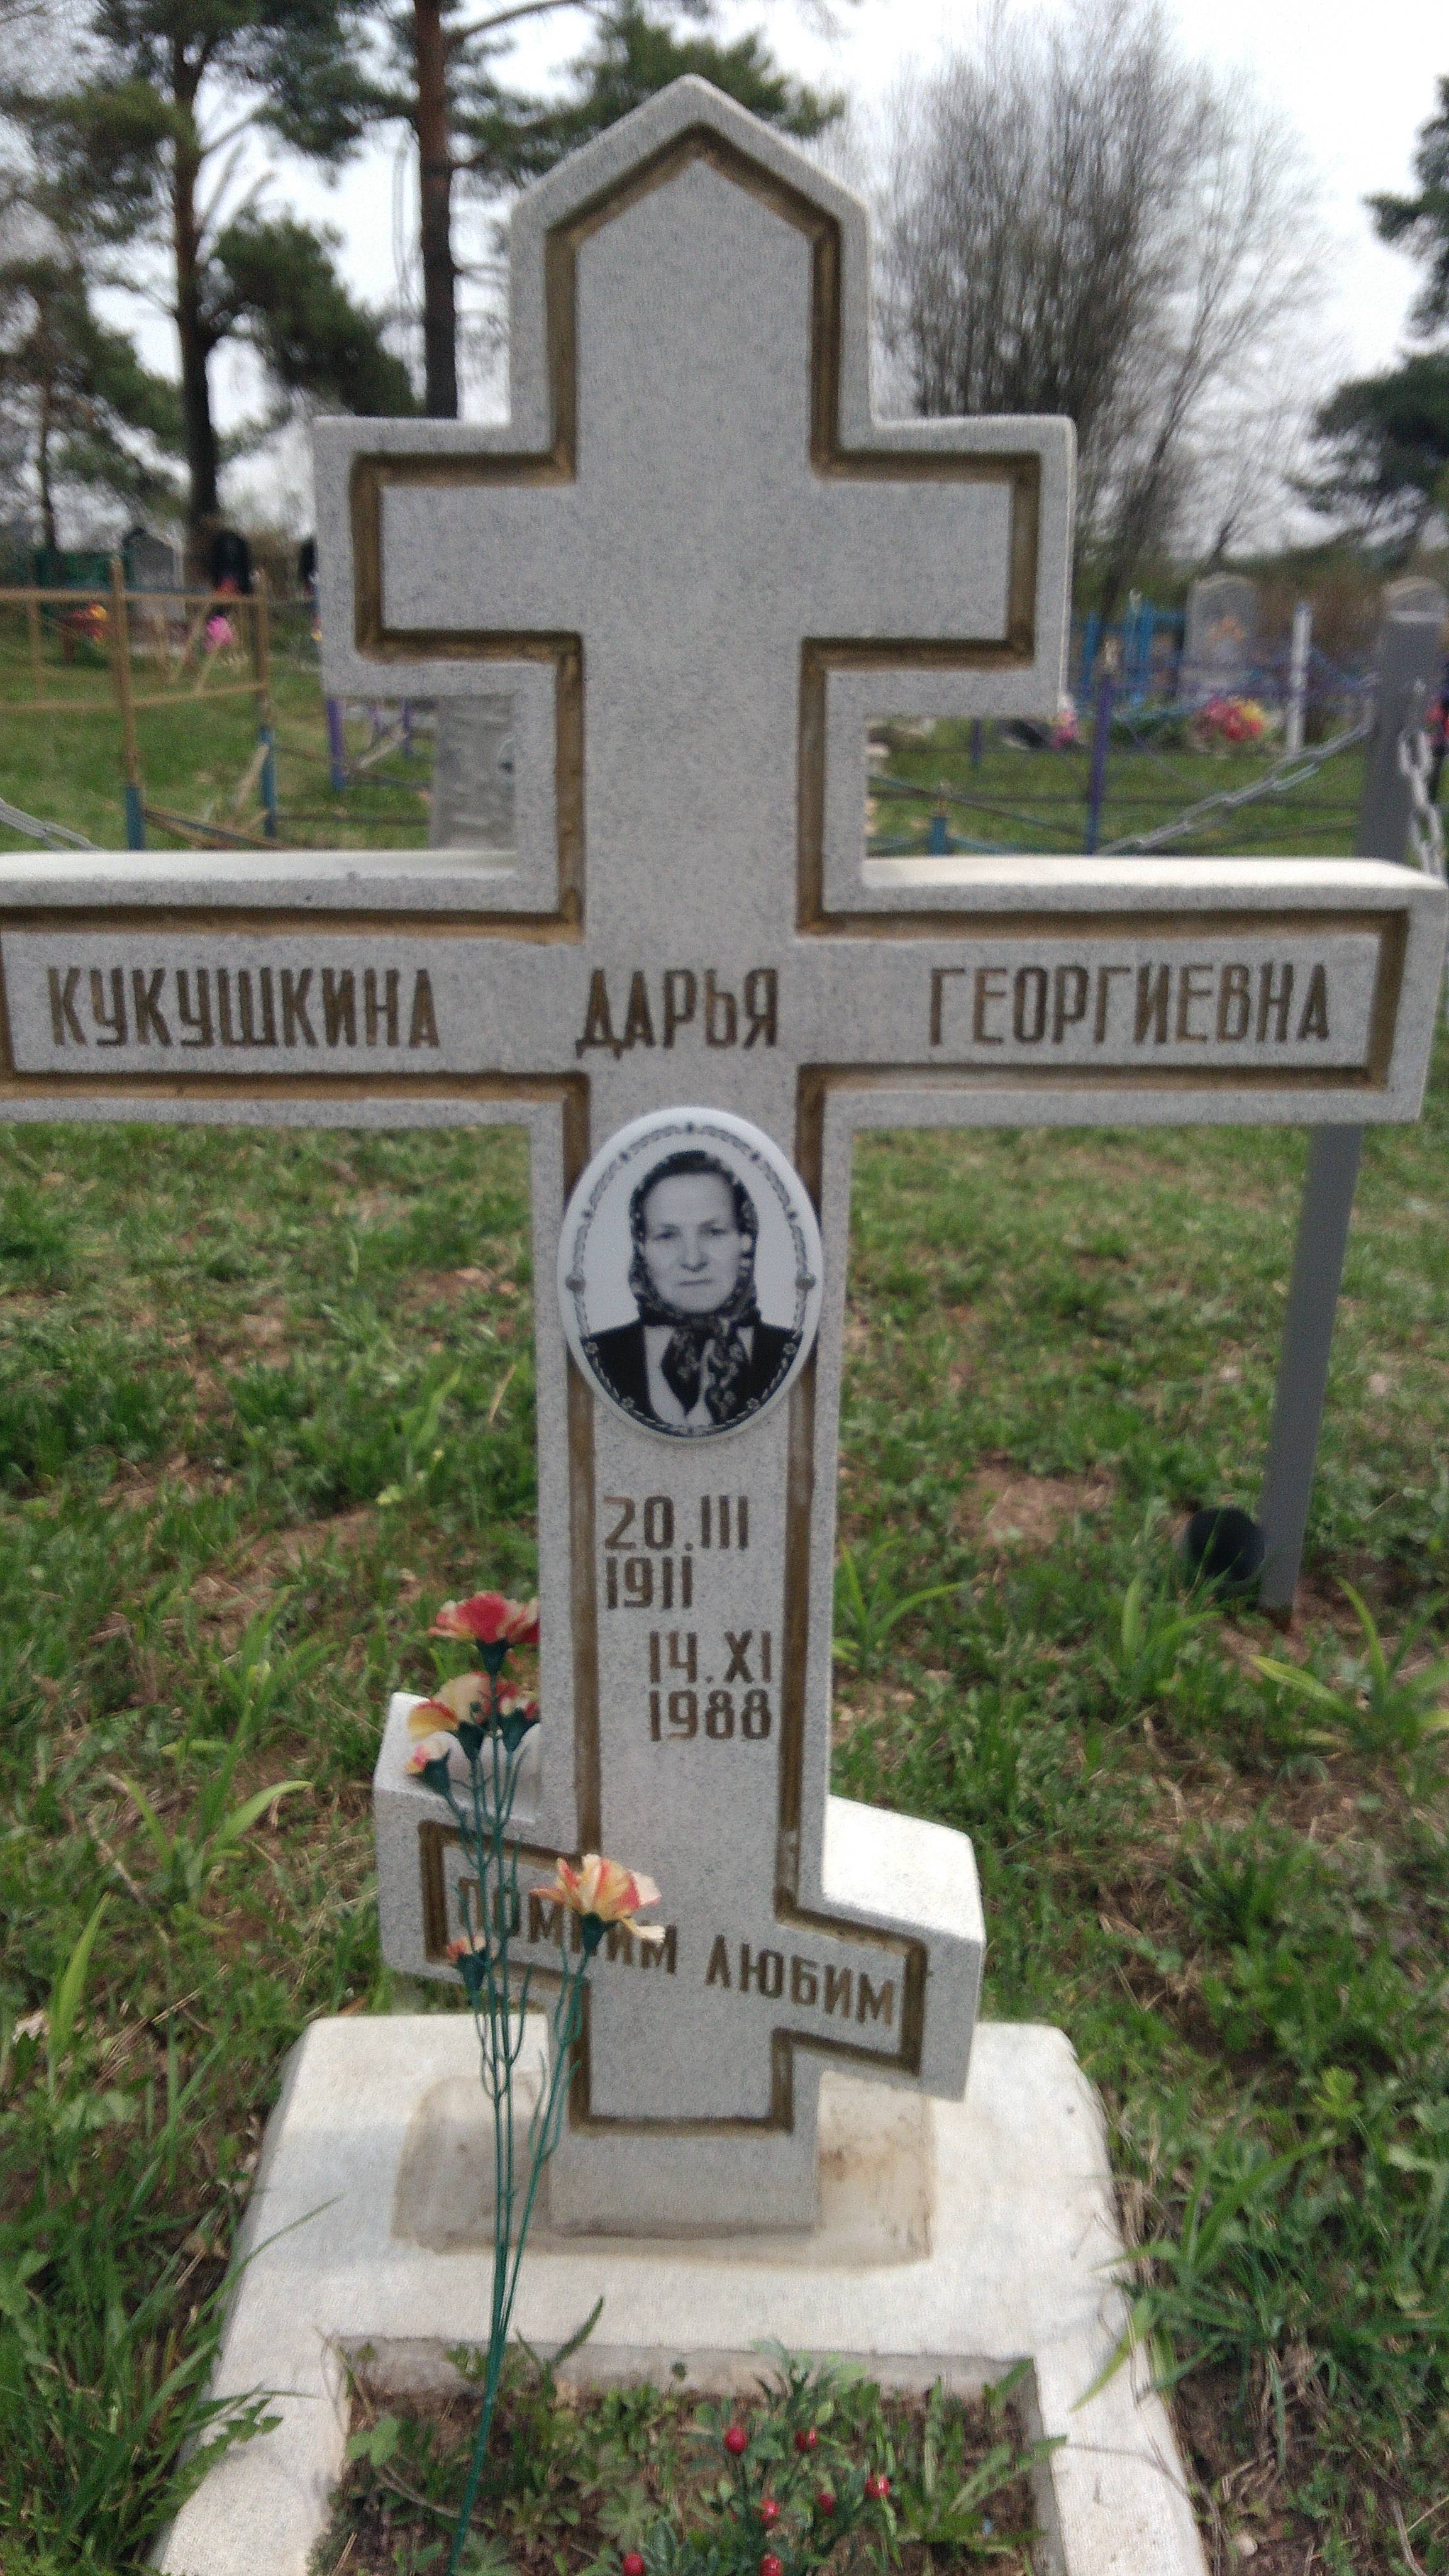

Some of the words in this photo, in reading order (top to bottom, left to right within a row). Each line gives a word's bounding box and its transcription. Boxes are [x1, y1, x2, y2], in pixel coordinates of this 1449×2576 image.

[47, 967, 439, 1047] КУКУШКИНА
[575, 968, 778, 1060] ДАРЬЯ
[929, 960, 1330, 1046] ГЕОРГИЕВНА
[606, 1556, 693, 1609] 1911
[649, 1689, 772, 1741] 1988
[704, 1935, 894, 2028] ЛЮБИМ
